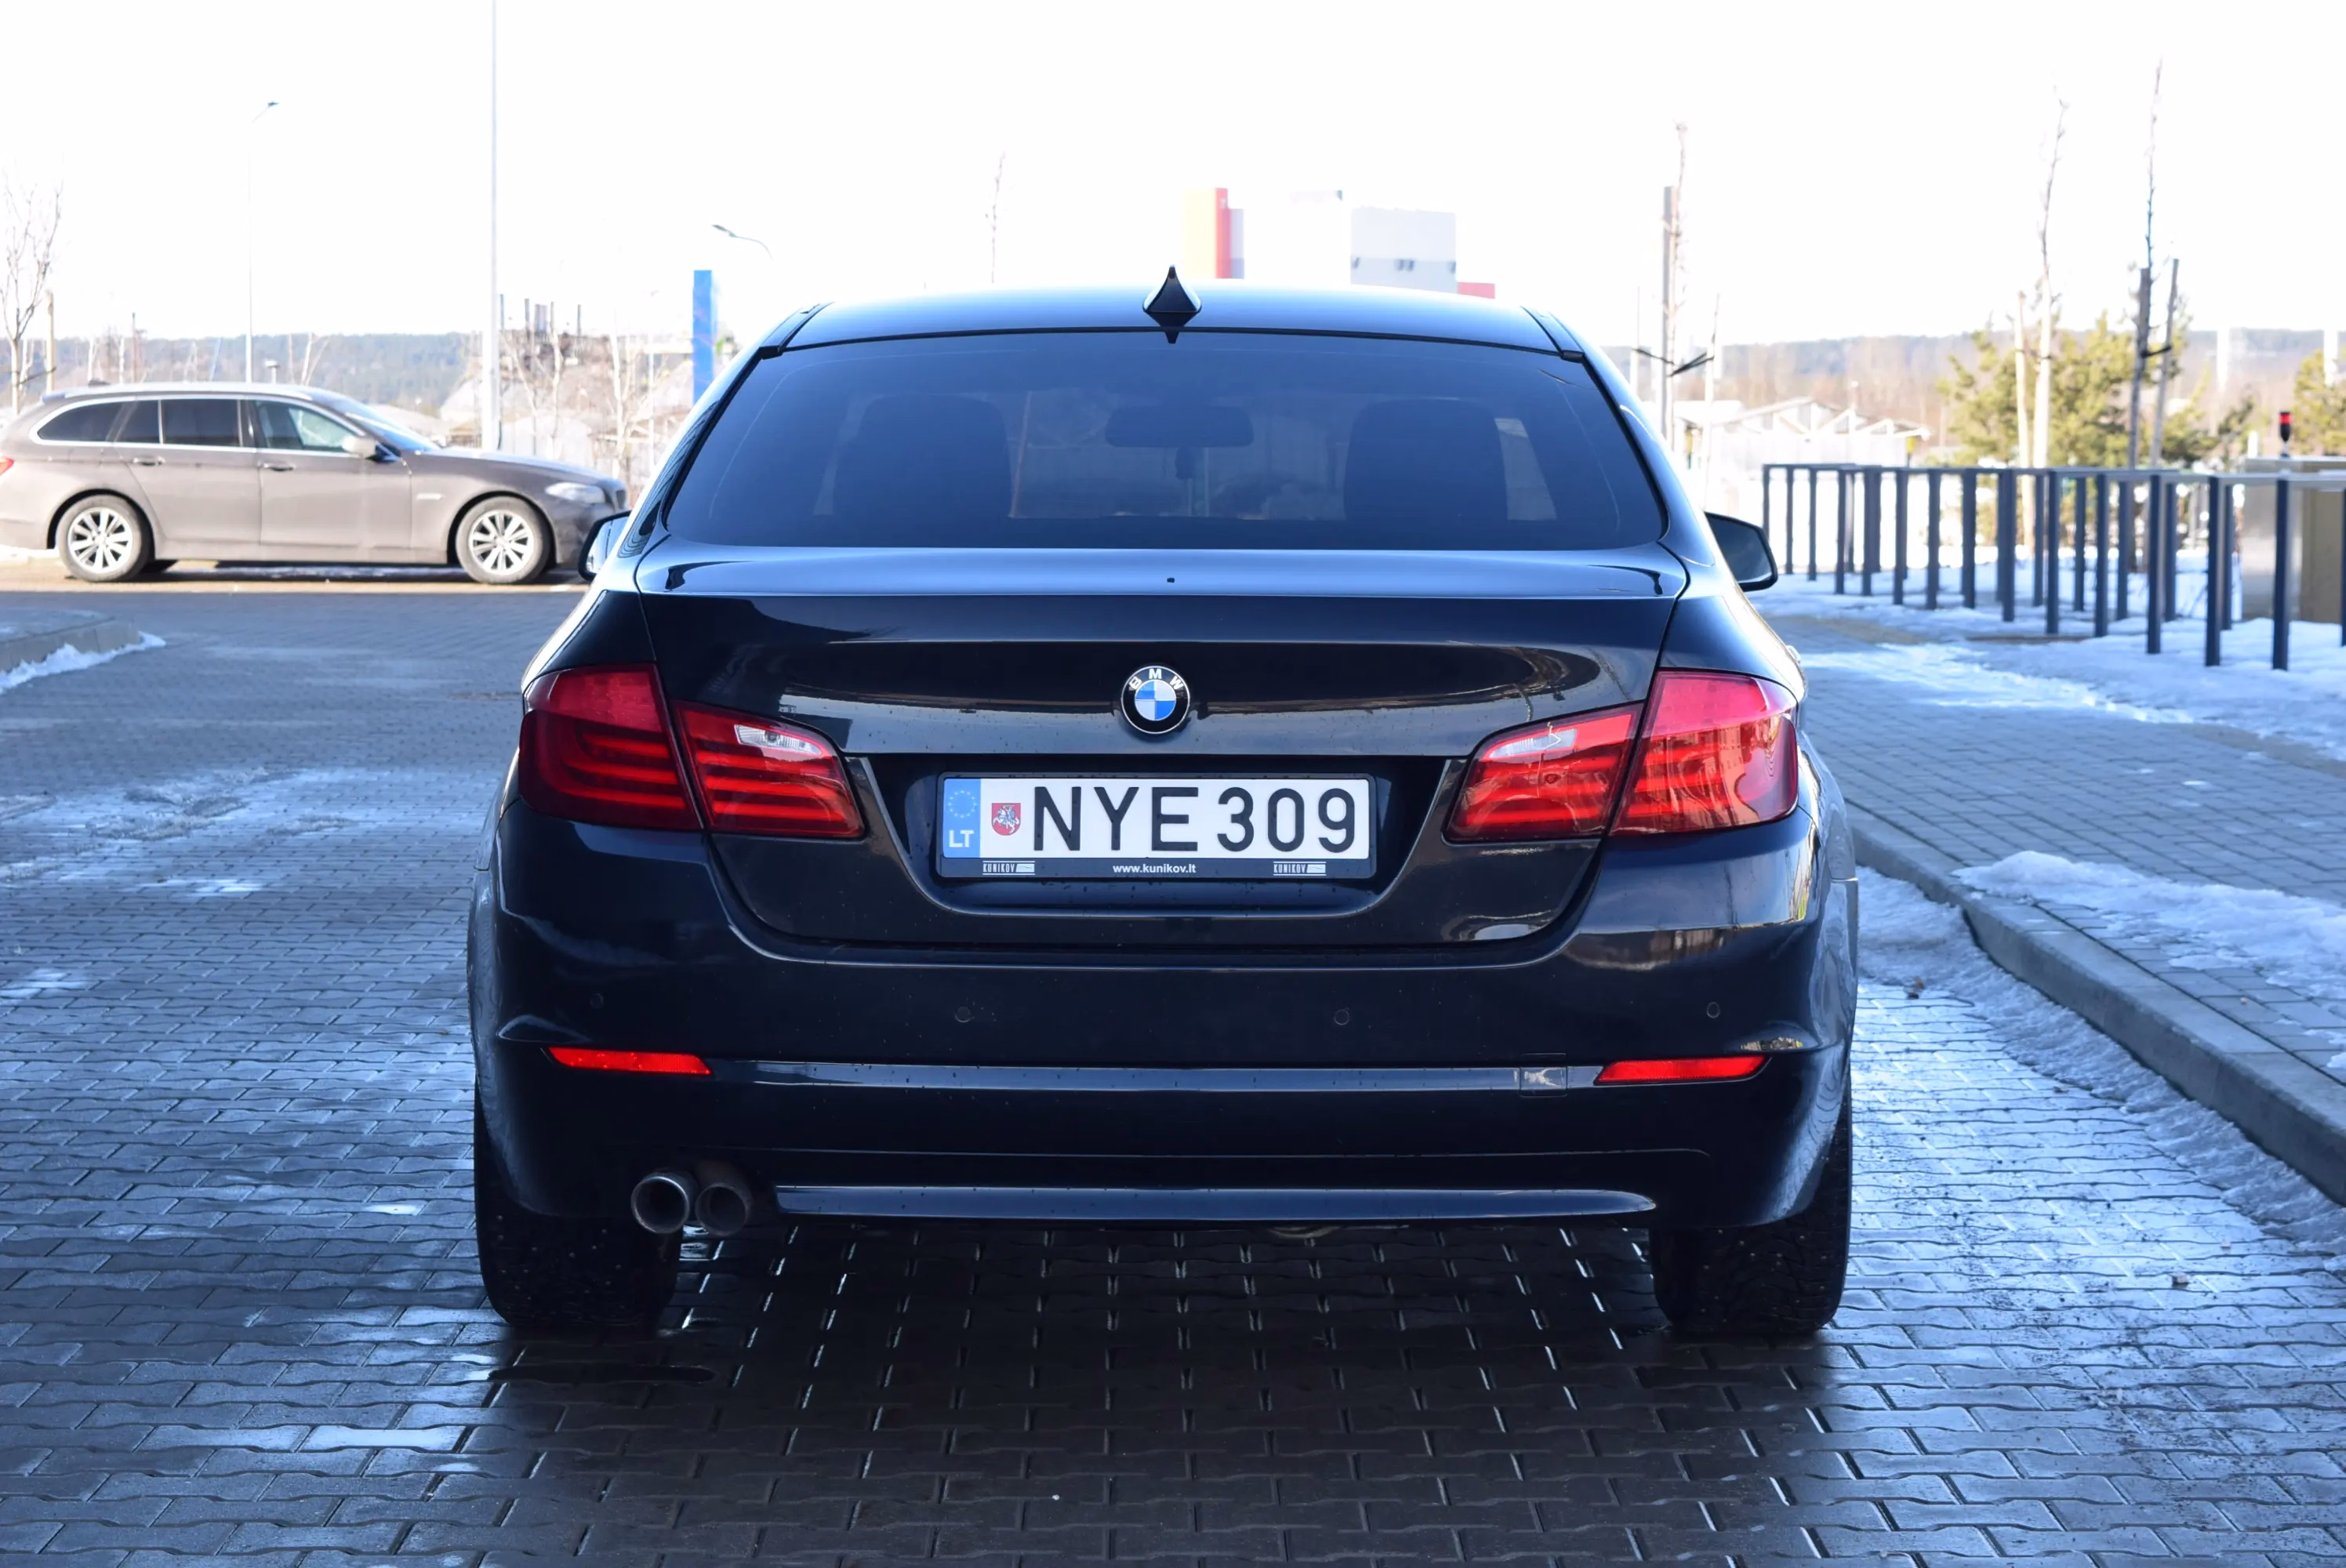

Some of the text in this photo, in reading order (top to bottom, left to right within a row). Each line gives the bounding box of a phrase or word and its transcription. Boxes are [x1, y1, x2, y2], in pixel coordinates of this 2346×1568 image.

[1129, 668, 1184, 690] BMW
[949, 829, 975, 848] LT
[982, 863, 1015, 873] KUNIKOV
[1113, 863, 1197, 873] www.kunikov.lt
[1273, 864, 1306, 873] KUNIKOV
